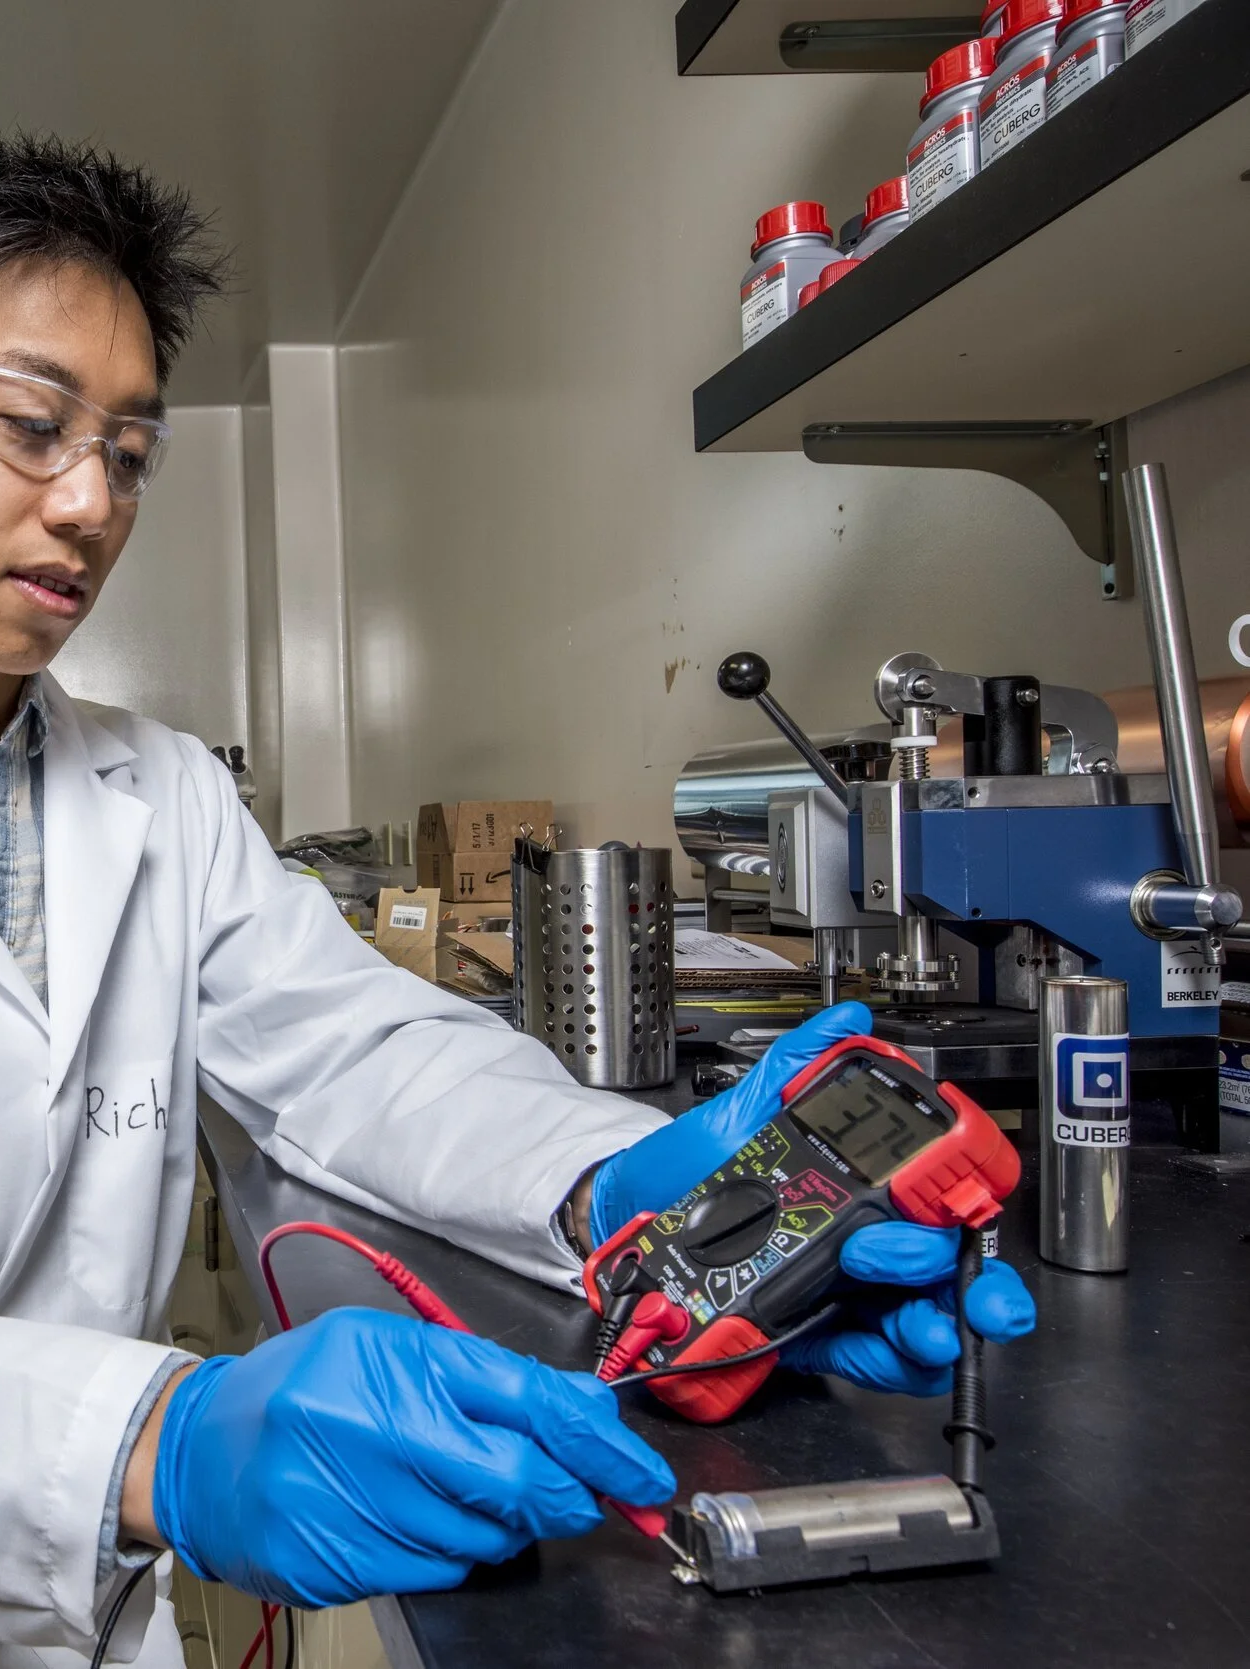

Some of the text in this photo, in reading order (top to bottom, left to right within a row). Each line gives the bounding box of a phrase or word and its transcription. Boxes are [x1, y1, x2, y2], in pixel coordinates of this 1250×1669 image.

[993, 103, 1041, 144] CUBERG
[915, 162, 954, 198] CUBERG
[746, 298, 775, 324] CUBERG
[472, 822, 481, 849] 5/1/17
[1167, 990, 1219, 1002] BERKELEY
[86, 1078, 168, 1140] Rich
[1056, 1123, 1130, 1143] CUBER
[806, 1133, 851, 1175] www.Equus.com
[771, 1167, 790, 1183] OFF
[666, 1244, 678, 1257] Auto
[685, 1266, 697, 1280] OFF
